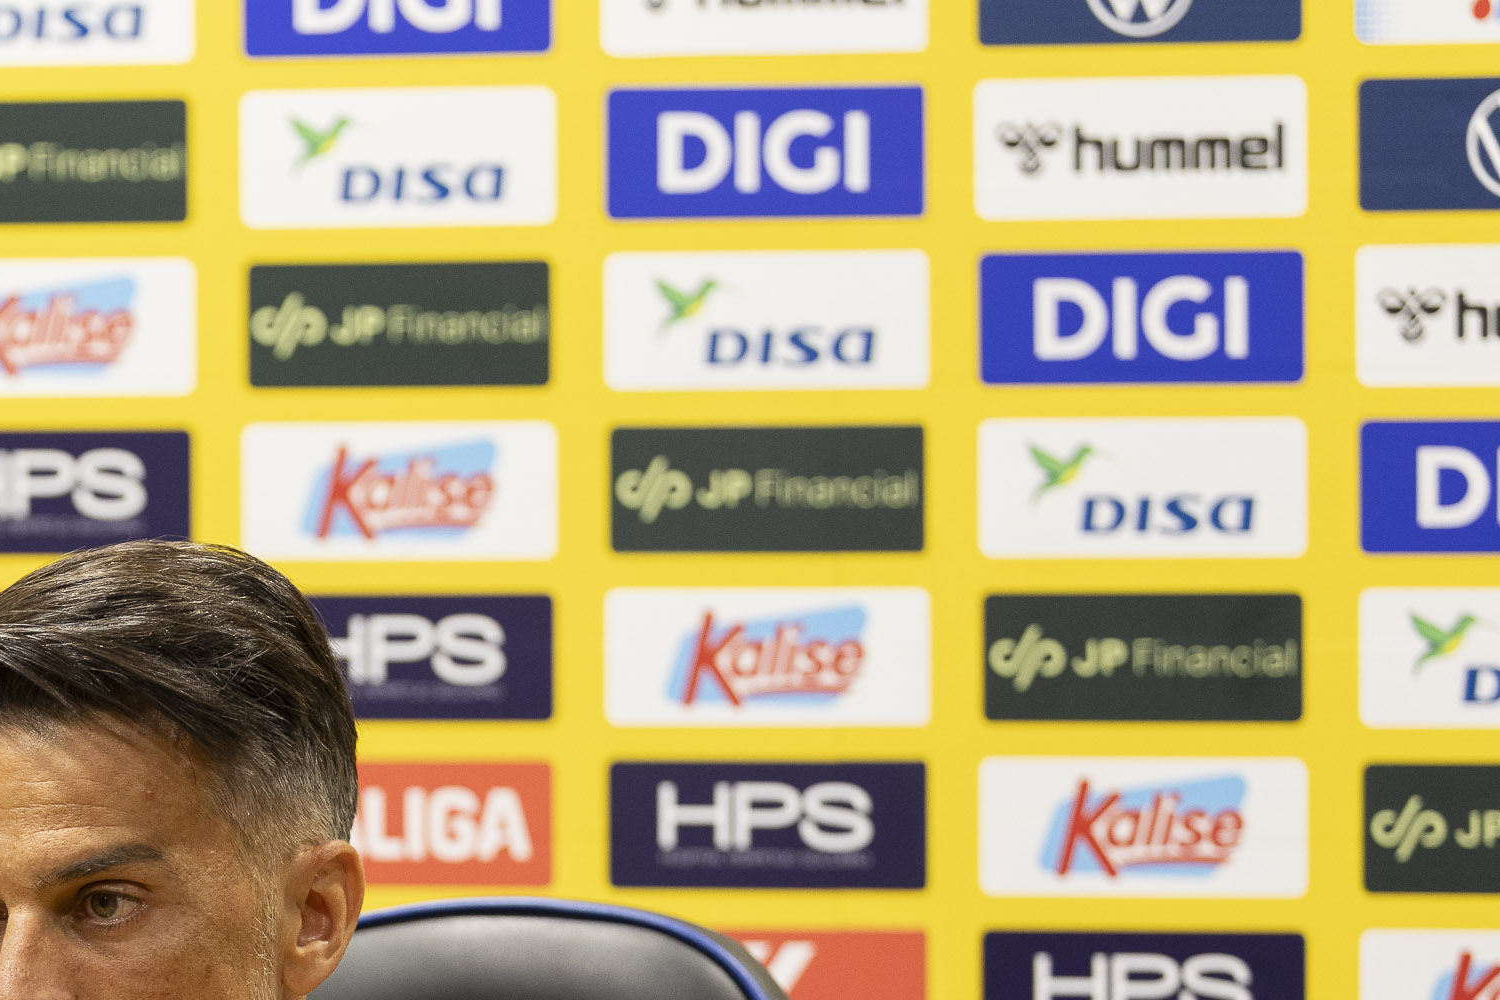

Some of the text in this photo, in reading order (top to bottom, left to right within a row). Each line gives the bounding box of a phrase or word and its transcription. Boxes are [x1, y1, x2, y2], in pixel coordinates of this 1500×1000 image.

[656, 109, 871, 195] DIGI
[1072, 122, 1286, 173] hummel
[329, 305, 385, 346] JP
[1032, 275, 1249, 361] DIGI
[314, 446, 496, 541] Kalise
[696, 469, 752, 509] JP
[682, 611, 866, 708] Kalise
[1072, 636, 1299, 677] JP Financial
[352, 786, 534, 863] LIGA
[656, 780, 875, 853] HPS
[1057, 779, 1245, 878] Kalise
